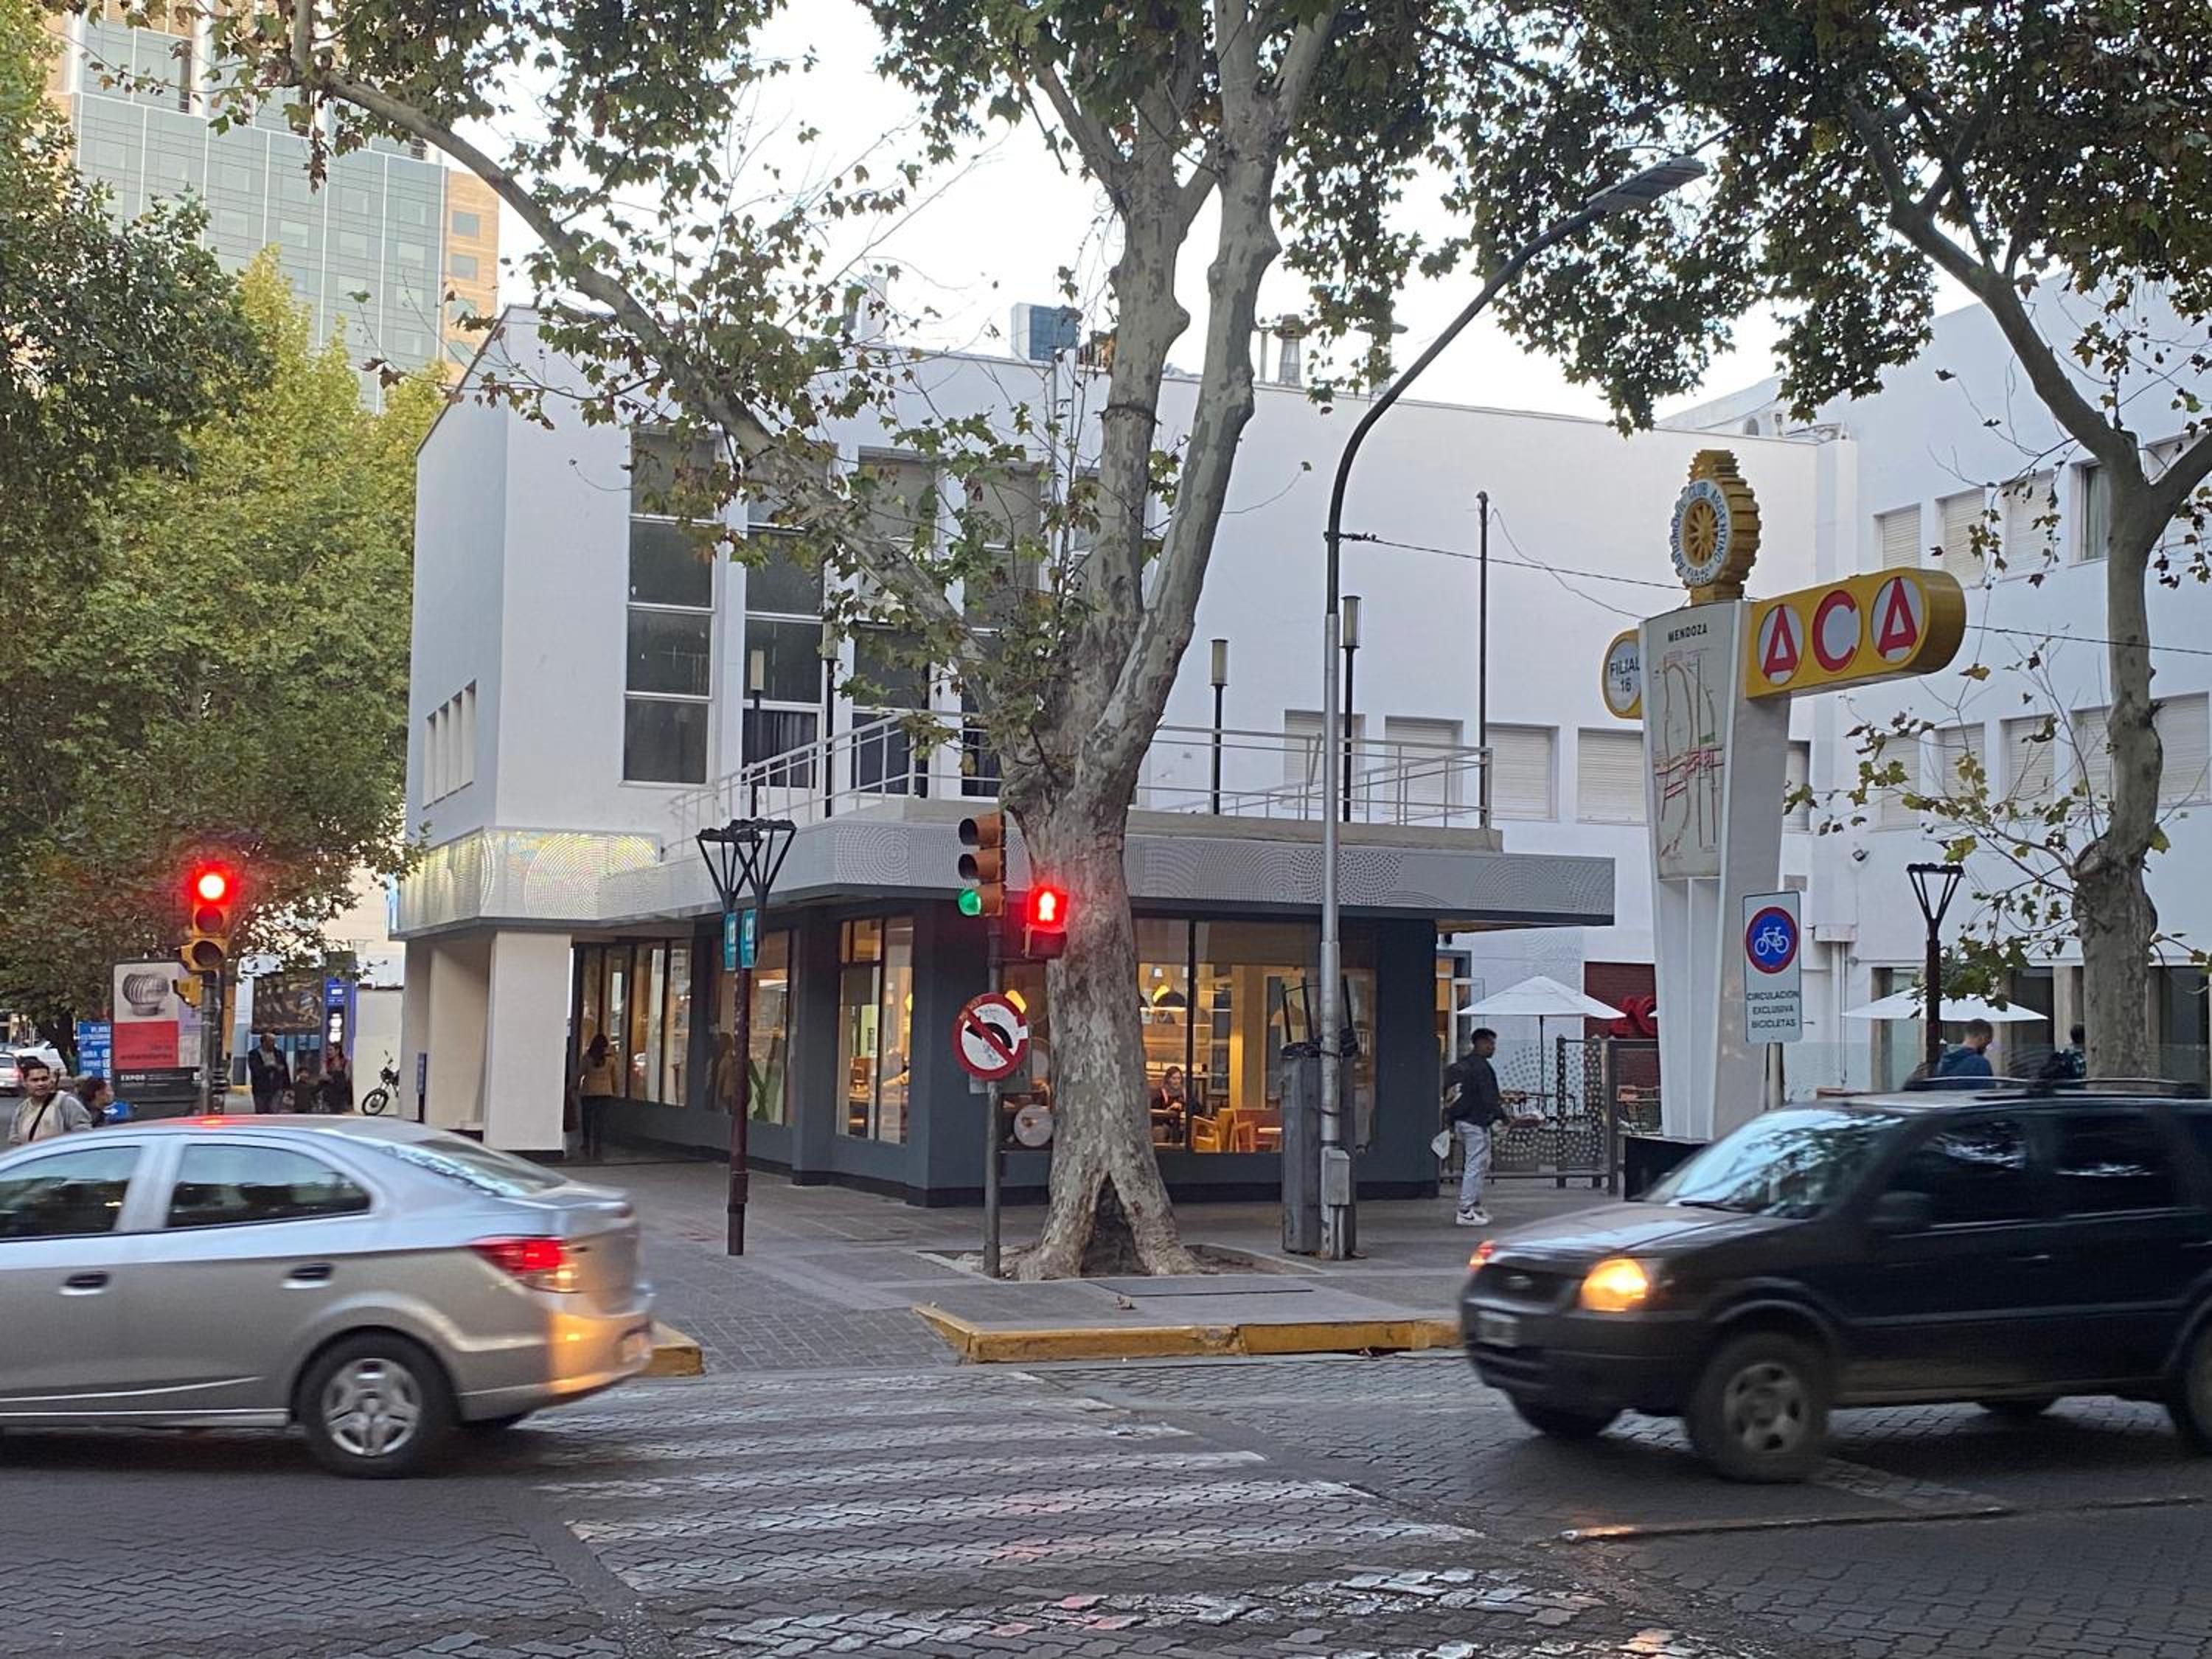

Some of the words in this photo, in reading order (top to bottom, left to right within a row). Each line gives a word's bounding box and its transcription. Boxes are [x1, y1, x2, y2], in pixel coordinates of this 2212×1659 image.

[1668, 623, 1708, 642] MENDOZA
[1762, 576, 1918, 680] ACA
[1610, 656, 1640, 676] FILIAL
[1621, 678, 1632, 692] 16
[1751, 1019, 1795, 1028] BICICLETAS
